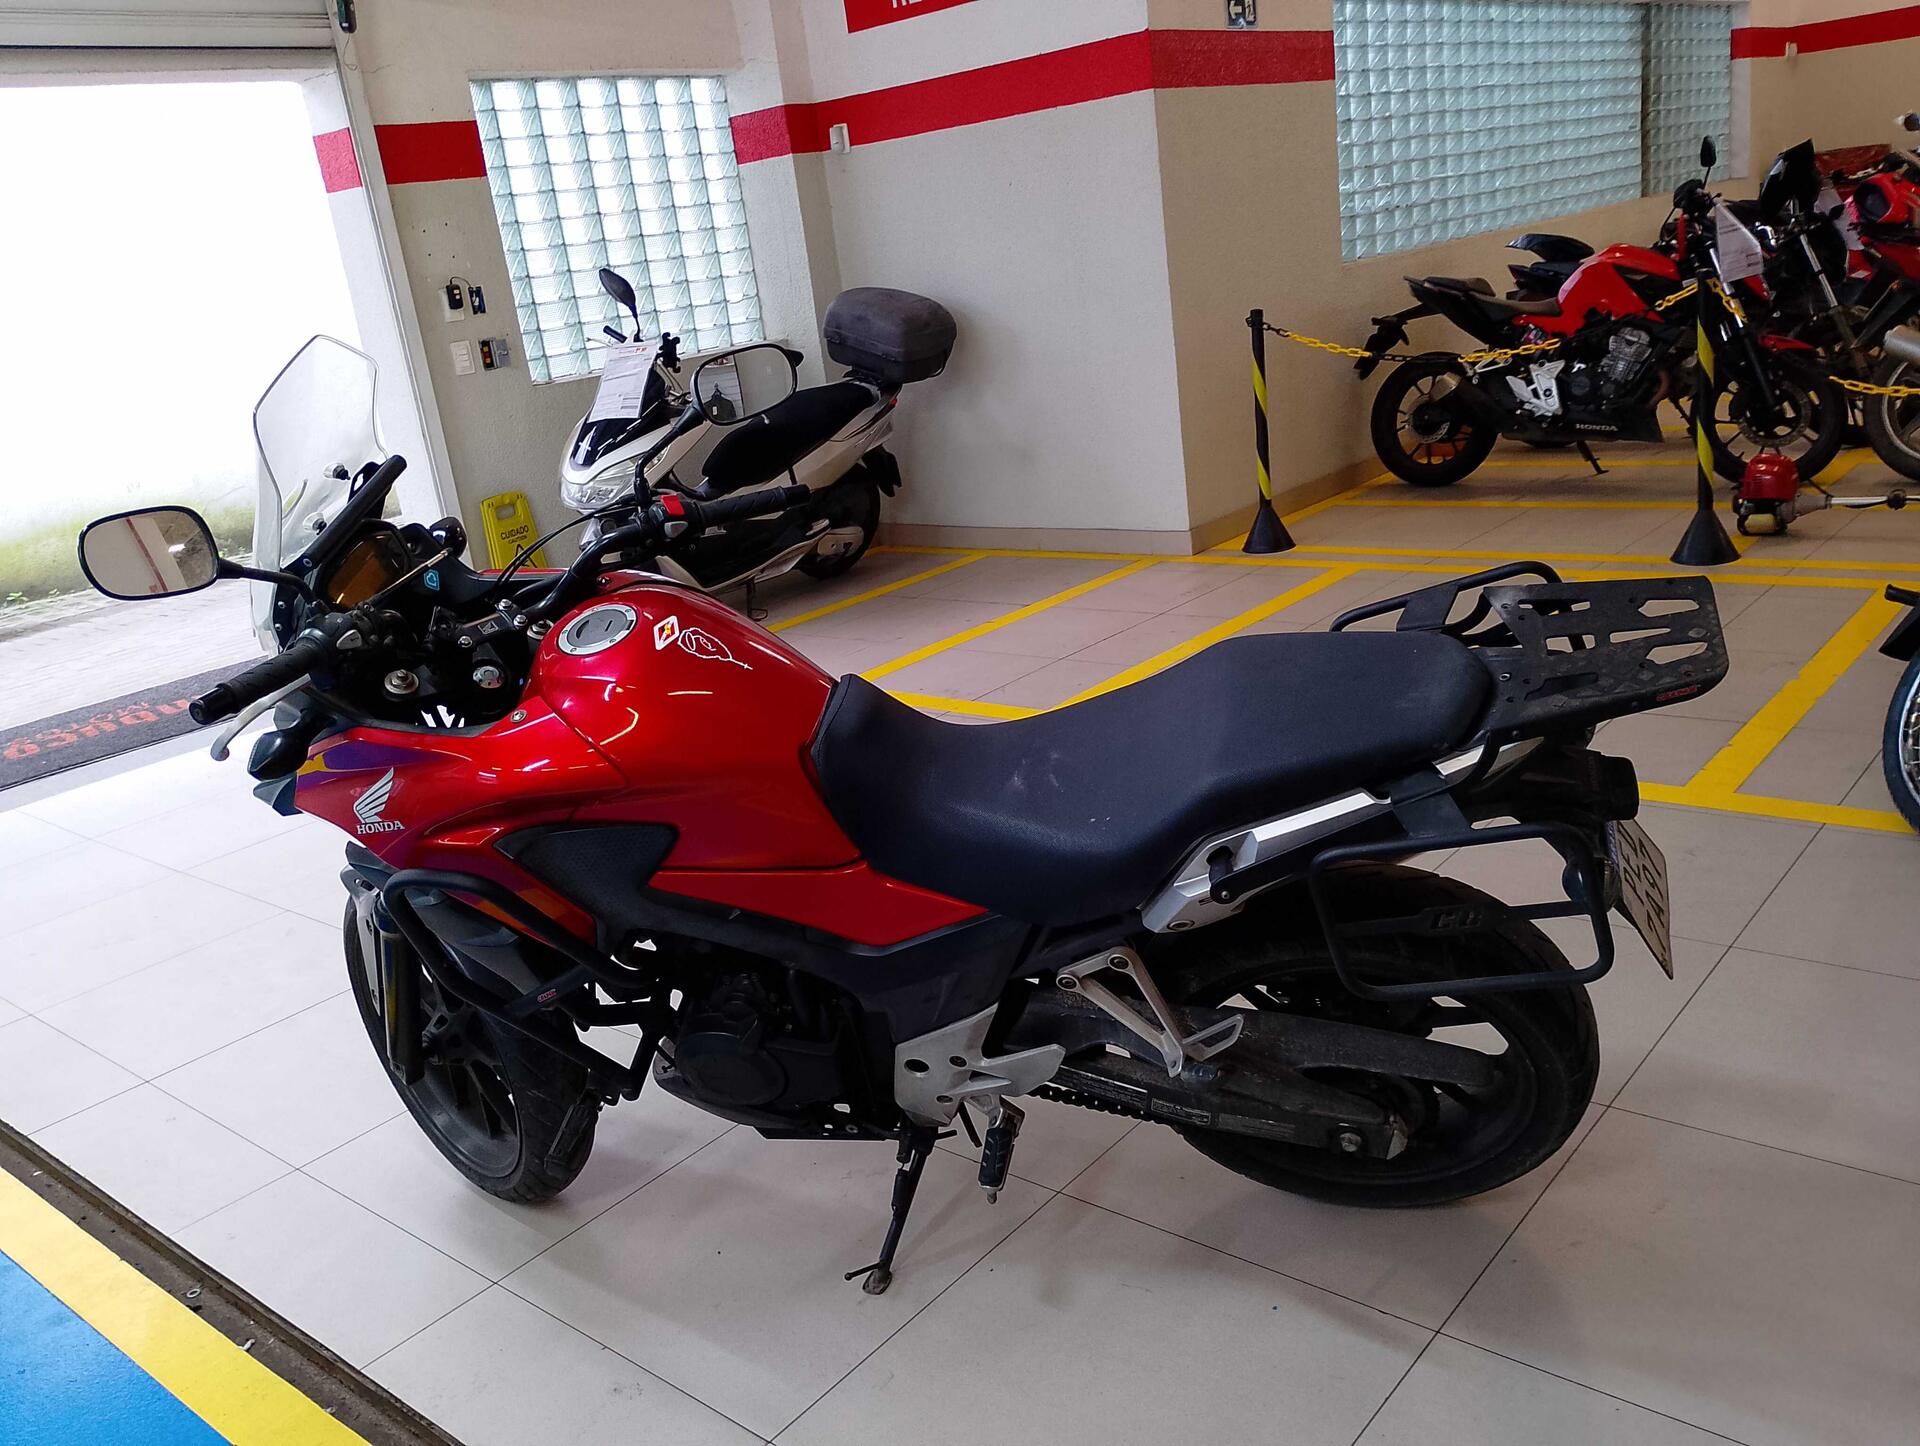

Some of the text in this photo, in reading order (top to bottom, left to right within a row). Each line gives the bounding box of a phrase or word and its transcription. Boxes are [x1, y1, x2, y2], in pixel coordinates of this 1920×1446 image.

[1575, 423, 1619, 432] HONDA
[500, 525, 529, 540] CUIDADO
[508, 535, 528, 544] CAUTION
[357, 820, 405, 835] HONDA
[1639, 837, 1667, 954] 7A97
